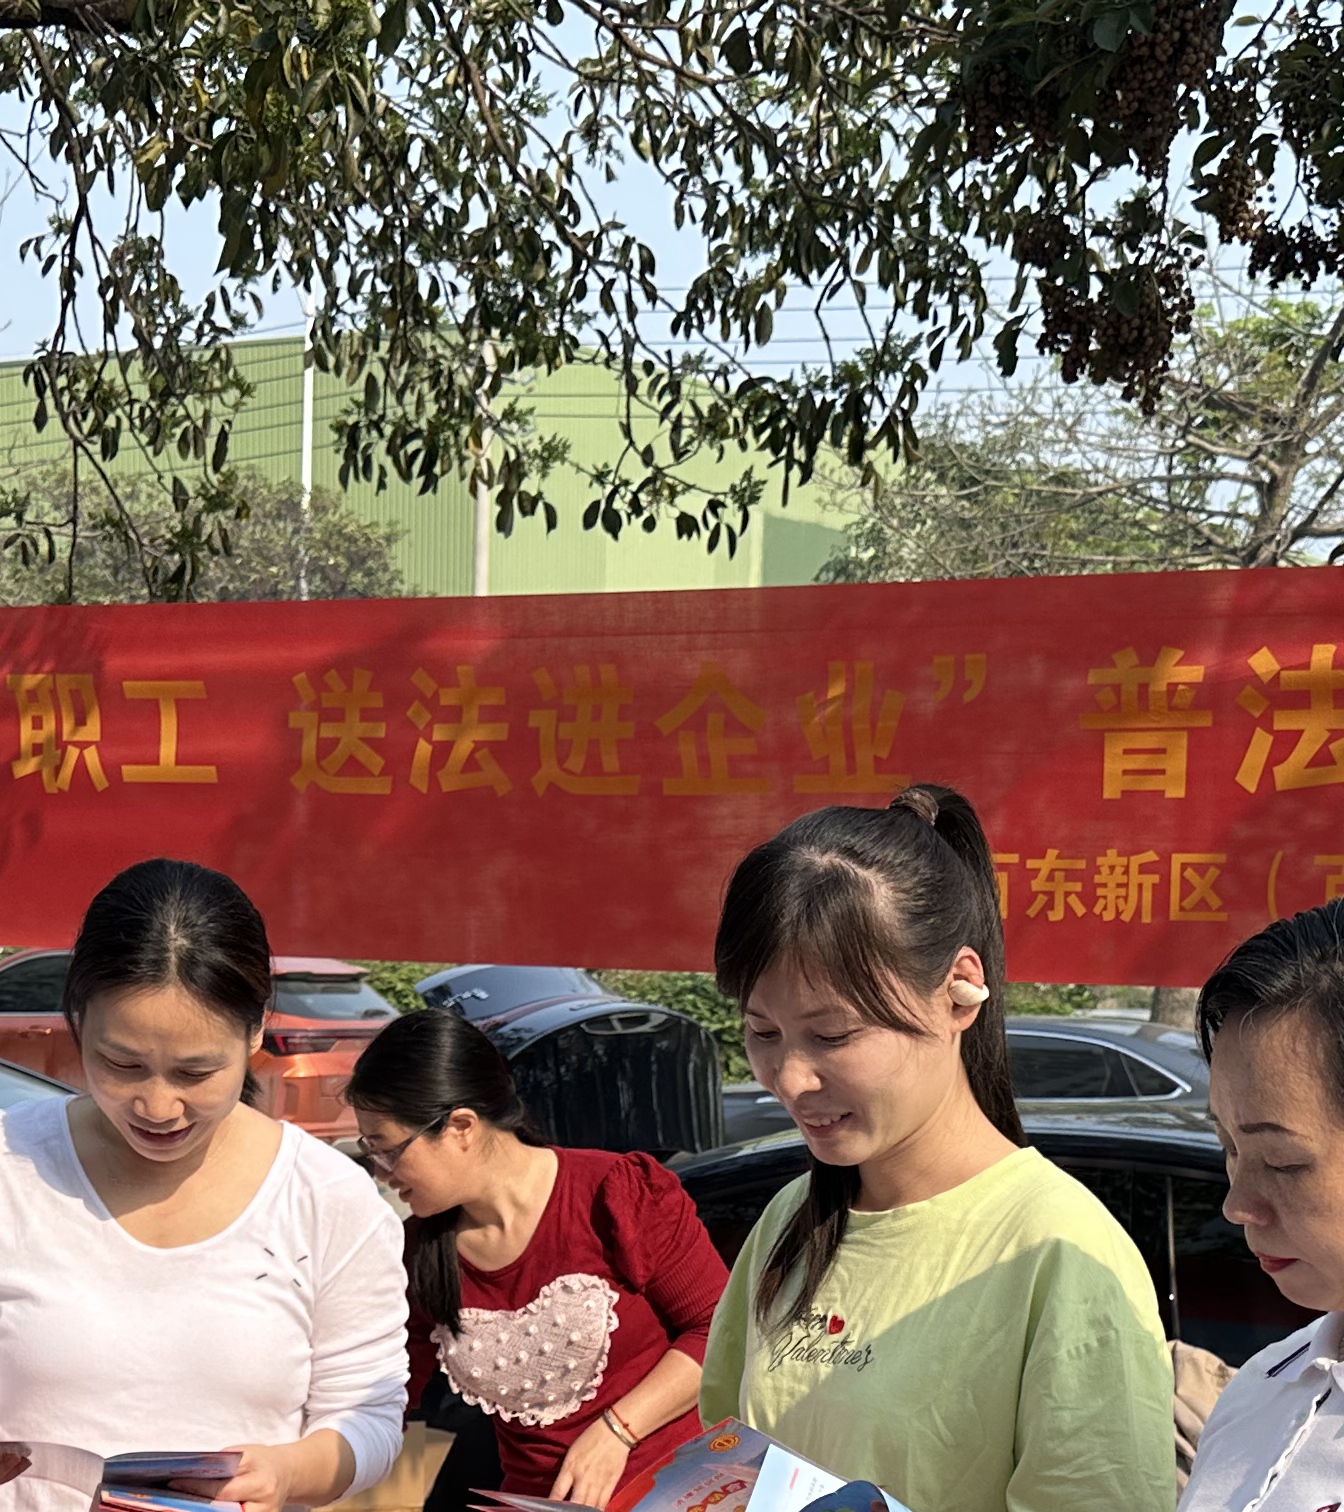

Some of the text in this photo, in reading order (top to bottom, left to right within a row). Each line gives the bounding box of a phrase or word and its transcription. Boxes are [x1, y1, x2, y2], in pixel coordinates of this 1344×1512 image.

[288, 652, 988, 796] 送法进企业”
